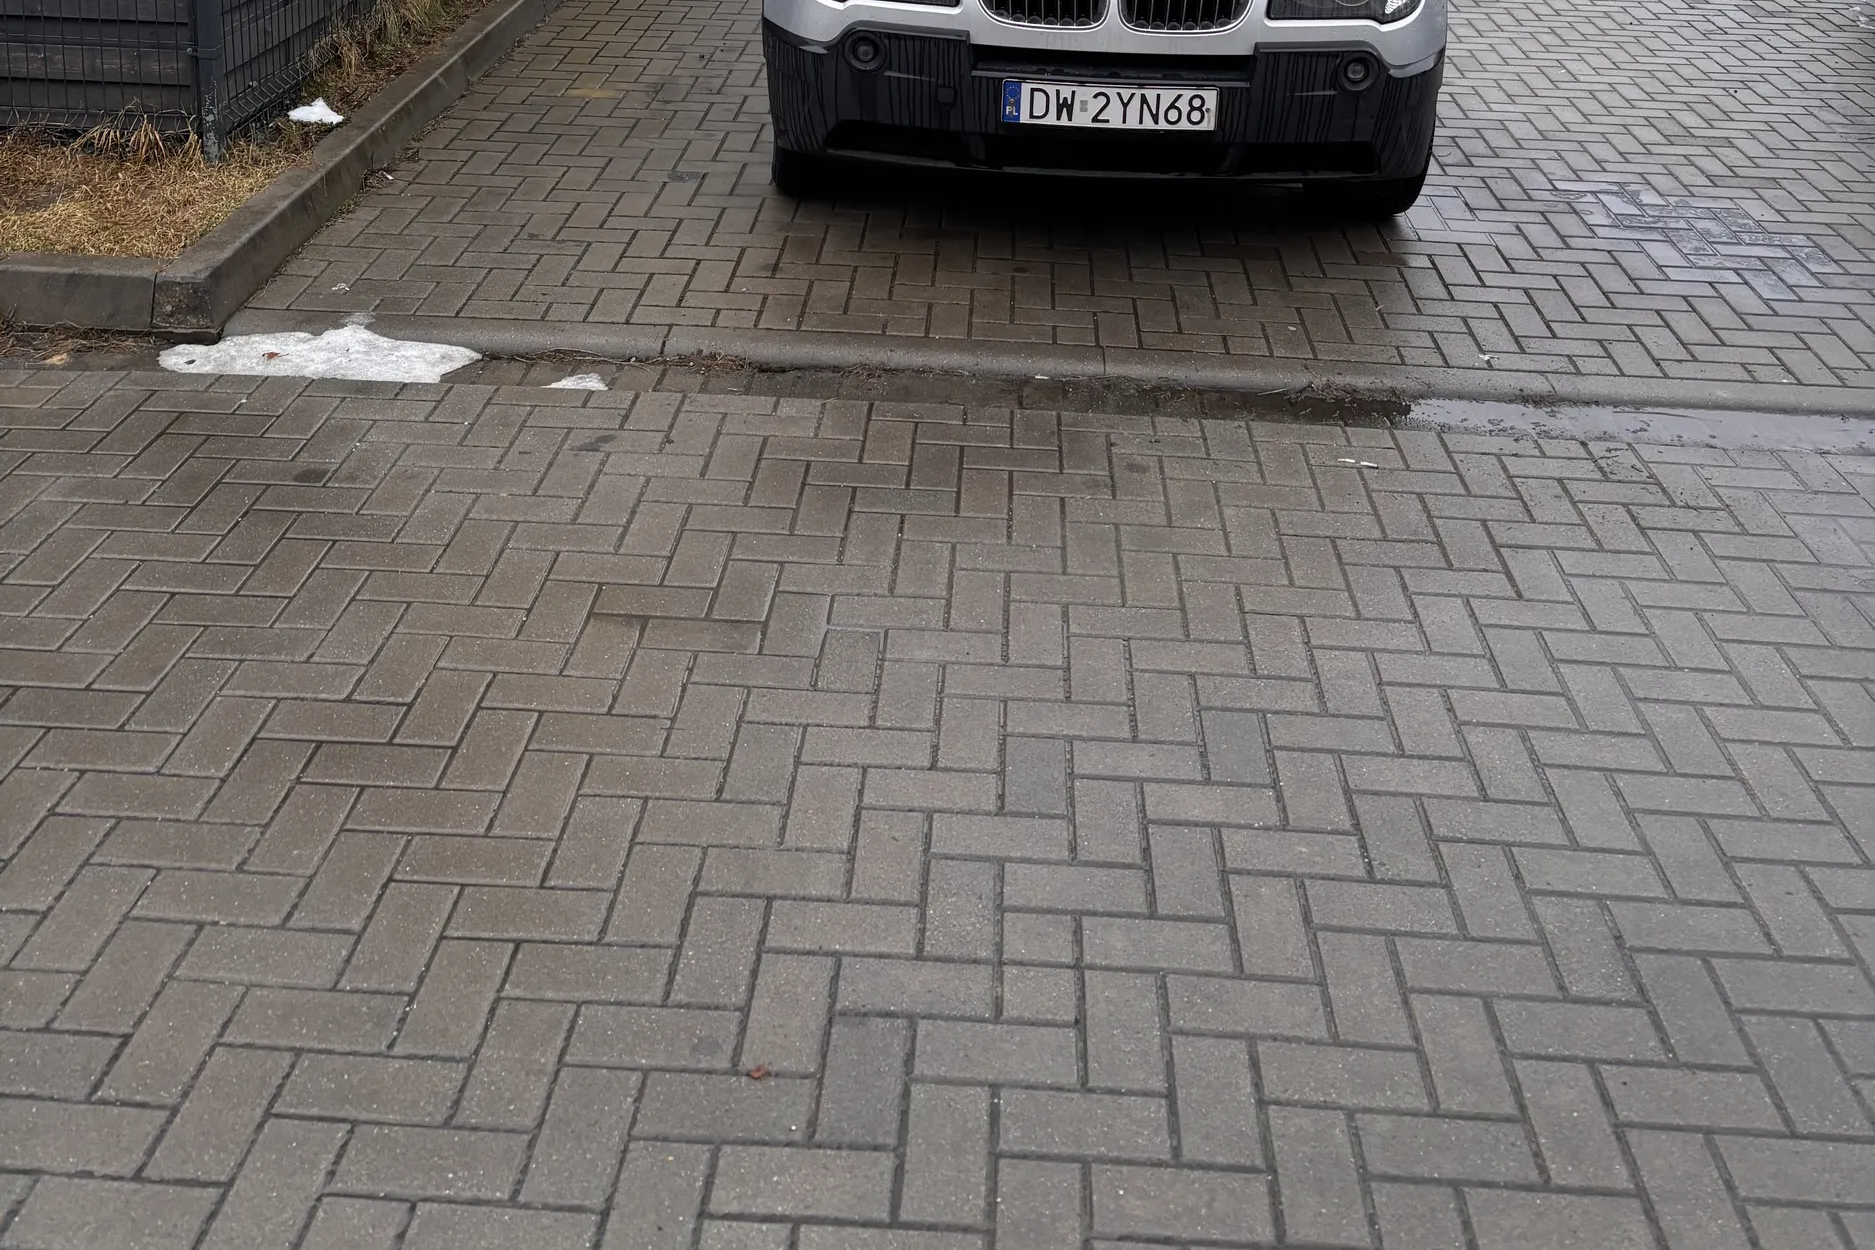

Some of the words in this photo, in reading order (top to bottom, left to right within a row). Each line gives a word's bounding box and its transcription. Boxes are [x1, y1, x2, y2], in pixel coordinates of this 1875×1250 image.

[1006, 105, 1018, 116] PL
[1029, 87, 1076, 122] DW
[1091, 91, 1206, 126] 2YN68
